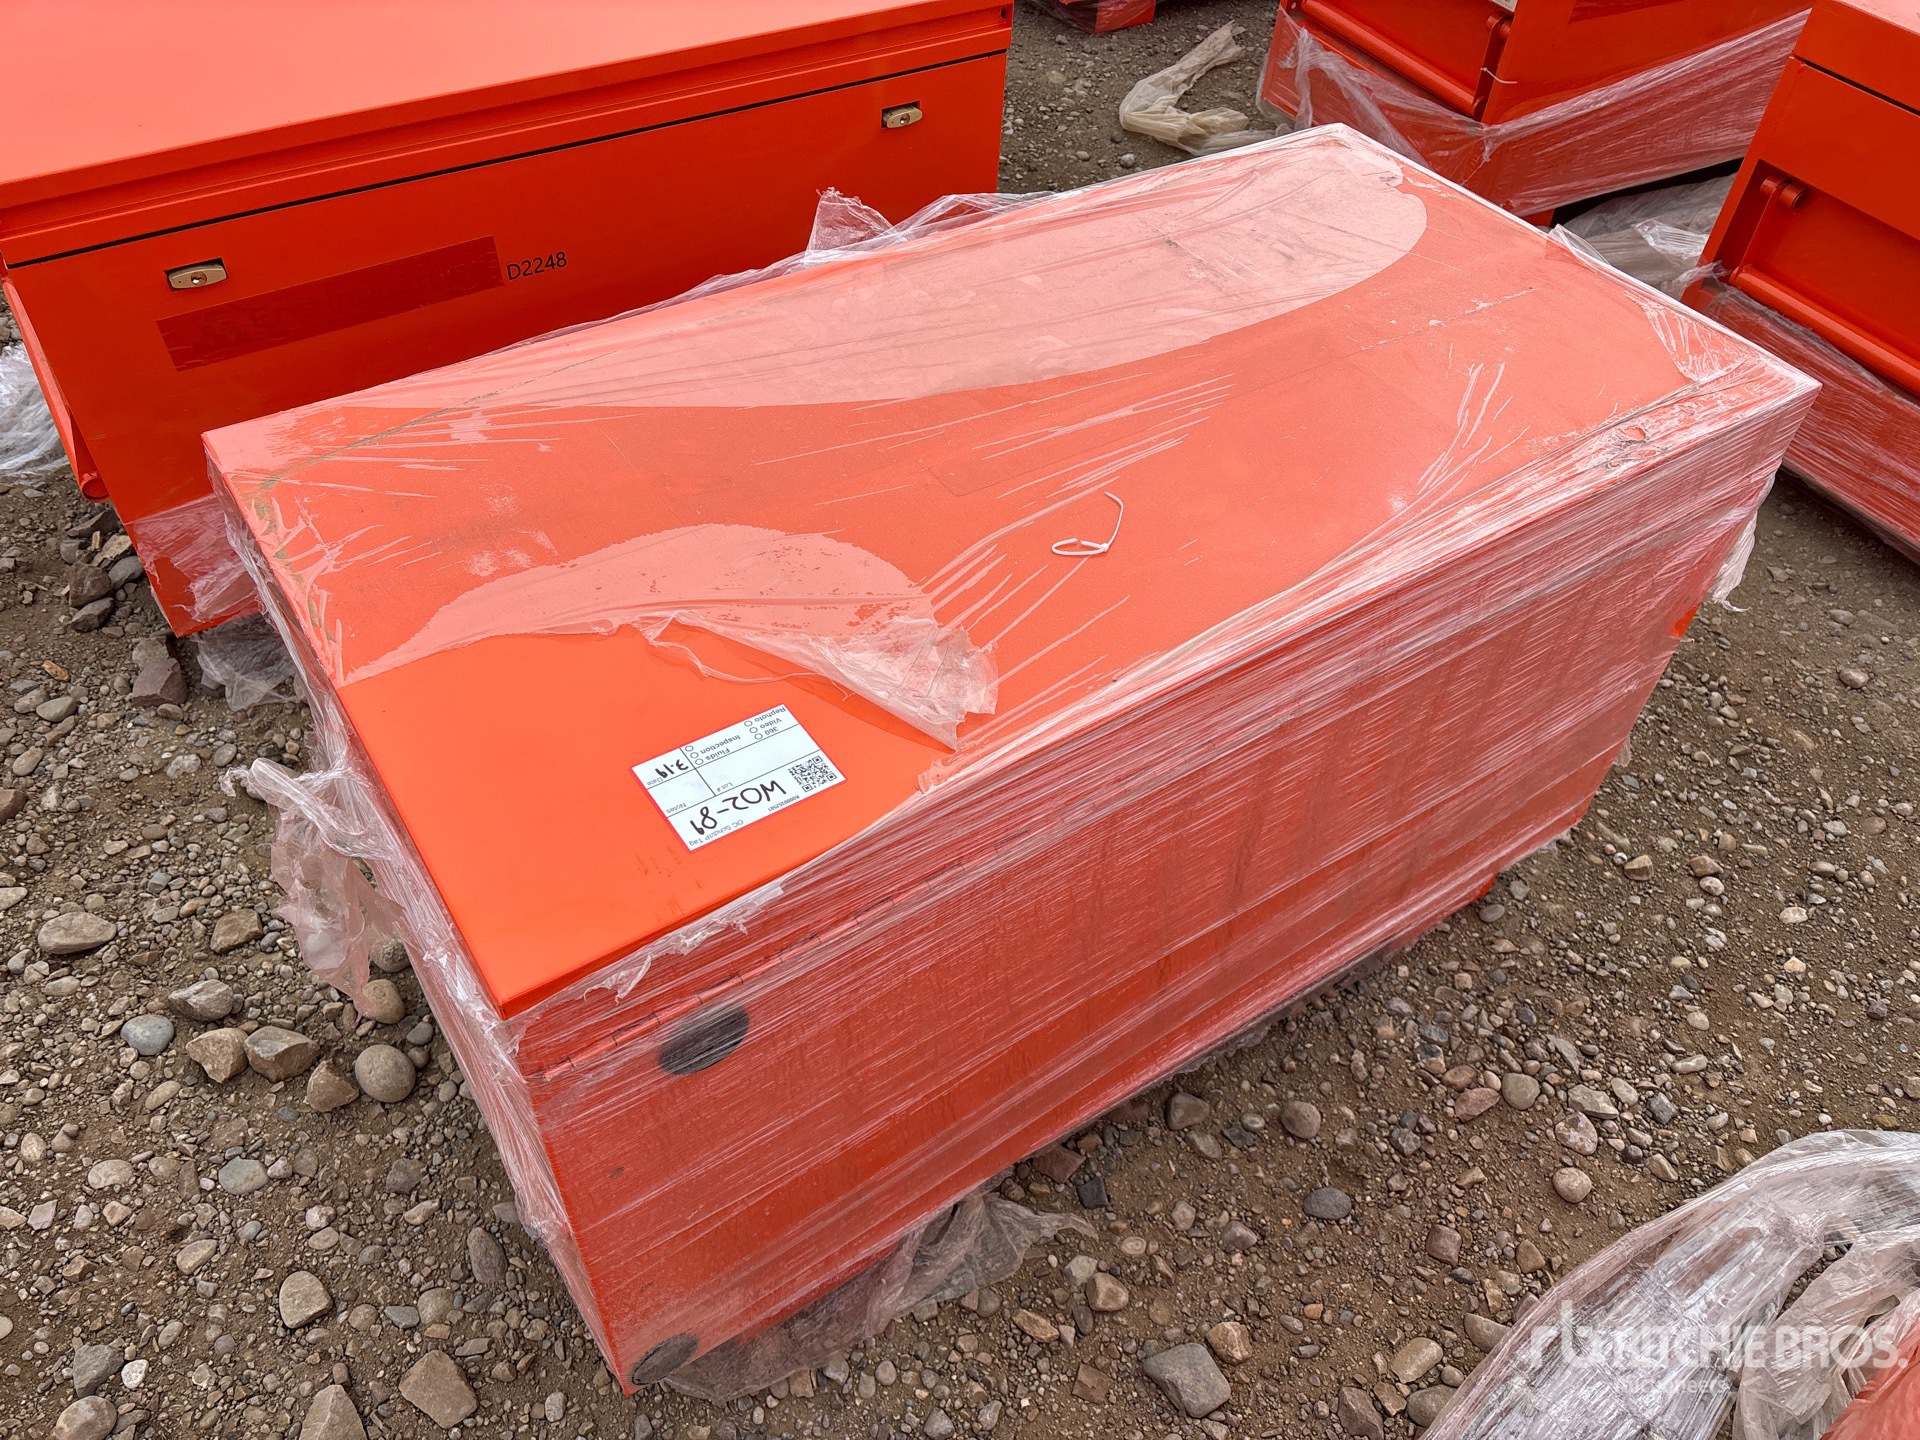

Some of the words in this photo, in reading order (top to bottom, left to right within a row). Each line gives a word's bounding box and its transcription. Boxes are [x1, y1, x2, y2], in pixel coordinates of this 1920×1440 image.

[507, 251, 567, 281] D2248
[754, 706, 786, 723] Rephoto
[759, 717, 782, 729] Video
[764, 727, 779, 737] 360
[700, 734, 741, 754] Inspection
[705, 748, 731, 761] Fluids
[655, 759, 689, 779] 3.19
[722, 782, 733, 791] Lot
[666, 802, 687, 814] Notes
[733, 820, 744, 828] OC
[688, 838, 704, 847] Tag
